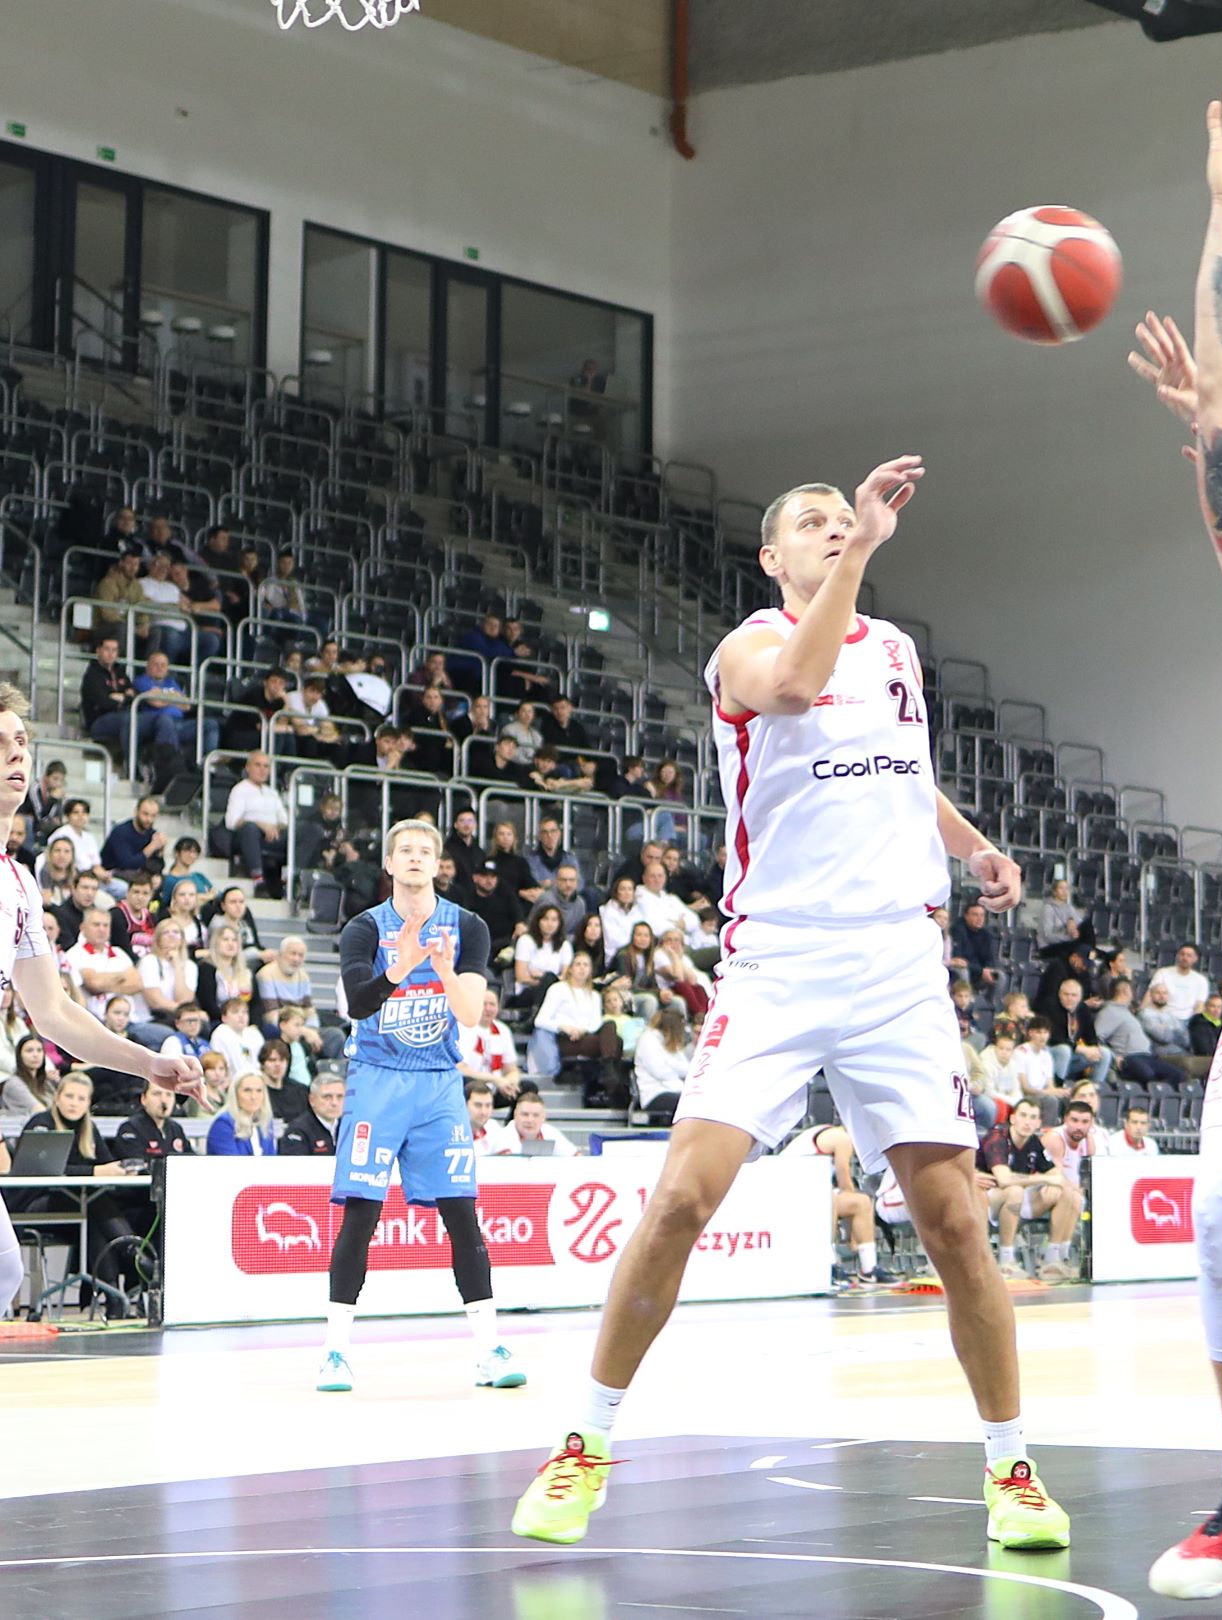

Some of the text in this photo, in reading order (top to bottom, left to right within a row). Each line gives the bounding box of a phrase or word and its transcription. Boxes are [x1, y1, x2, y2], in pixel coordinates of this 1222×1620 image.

[383, 996, 448, 1024] DECK
[444, 1148, 473, 1174] 77
[369, 1206, 533, 1246] ank Pkao
[695, 1231, 771, 1257] czyzn
